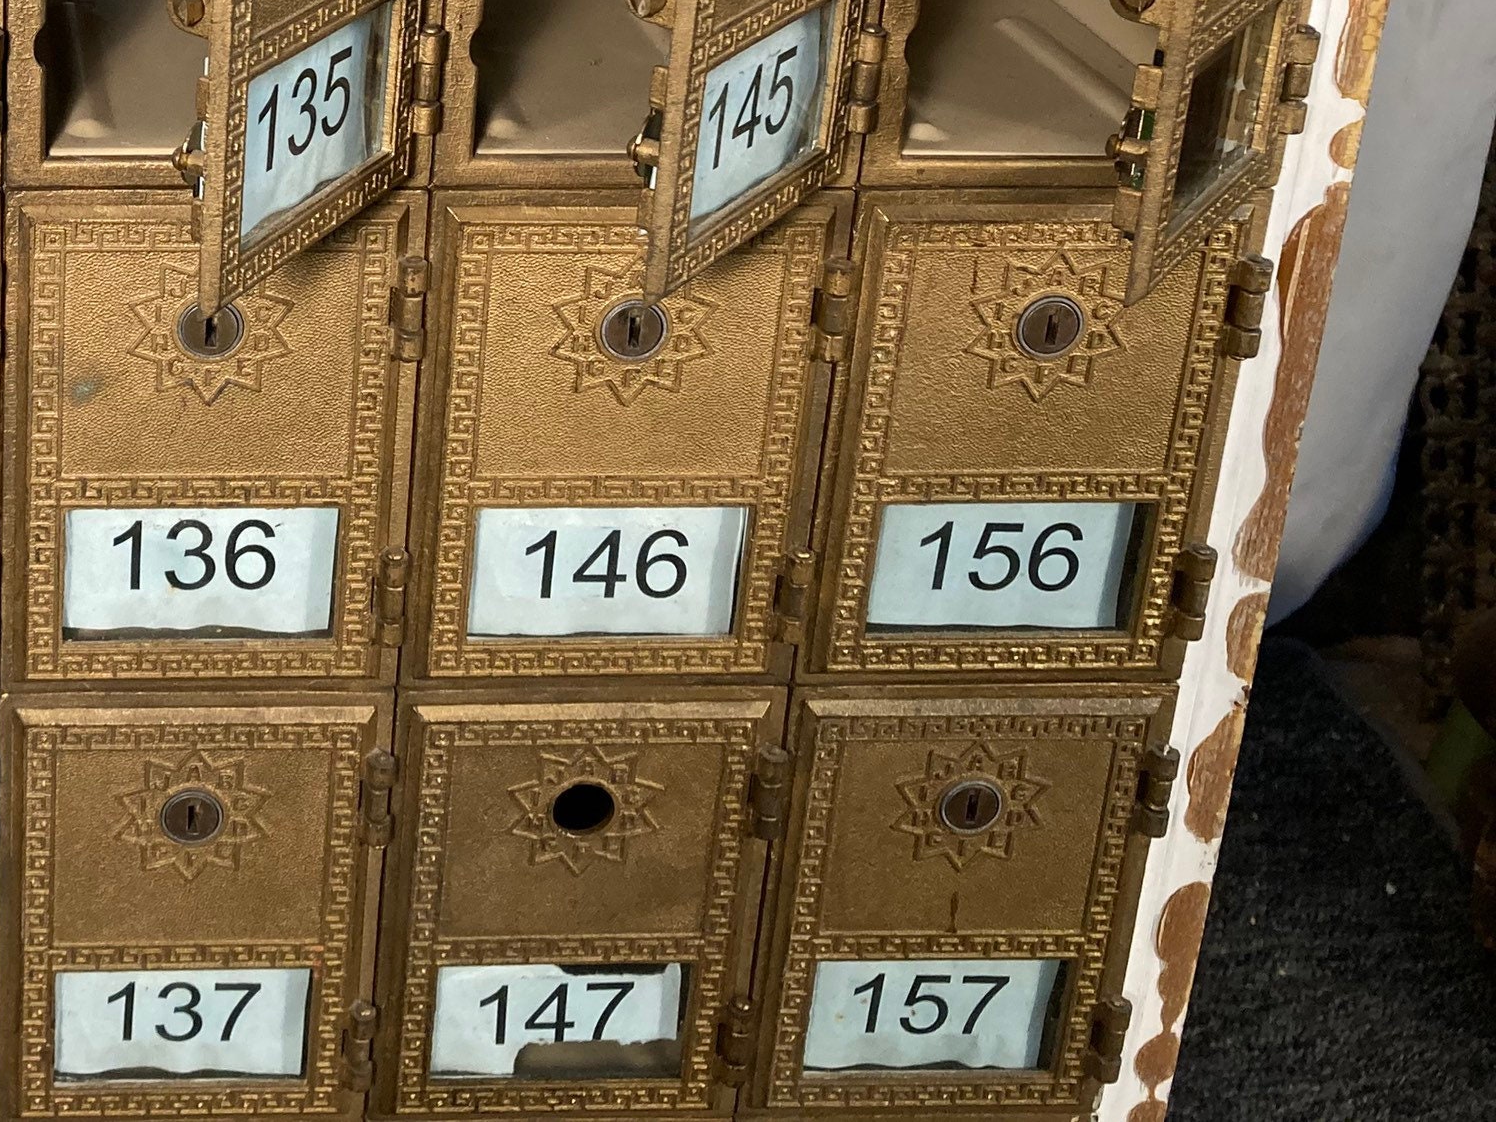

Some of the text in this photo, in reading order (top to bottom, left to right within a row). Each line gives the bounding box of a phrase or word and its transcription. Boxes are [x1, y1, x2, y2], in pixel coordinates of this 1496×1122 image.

[258, 46, 352, 171] 135
[709, 47, 798, 169] 145
[114, 520, 275, 590] 136
[526, 530, 688, 598] 146
[921, 522, 1083, 591] 156
[108, 982, 261, 1041] 137
[480, 982, 635, 1045] 147
[854, 974, 1010, 1034] 157
